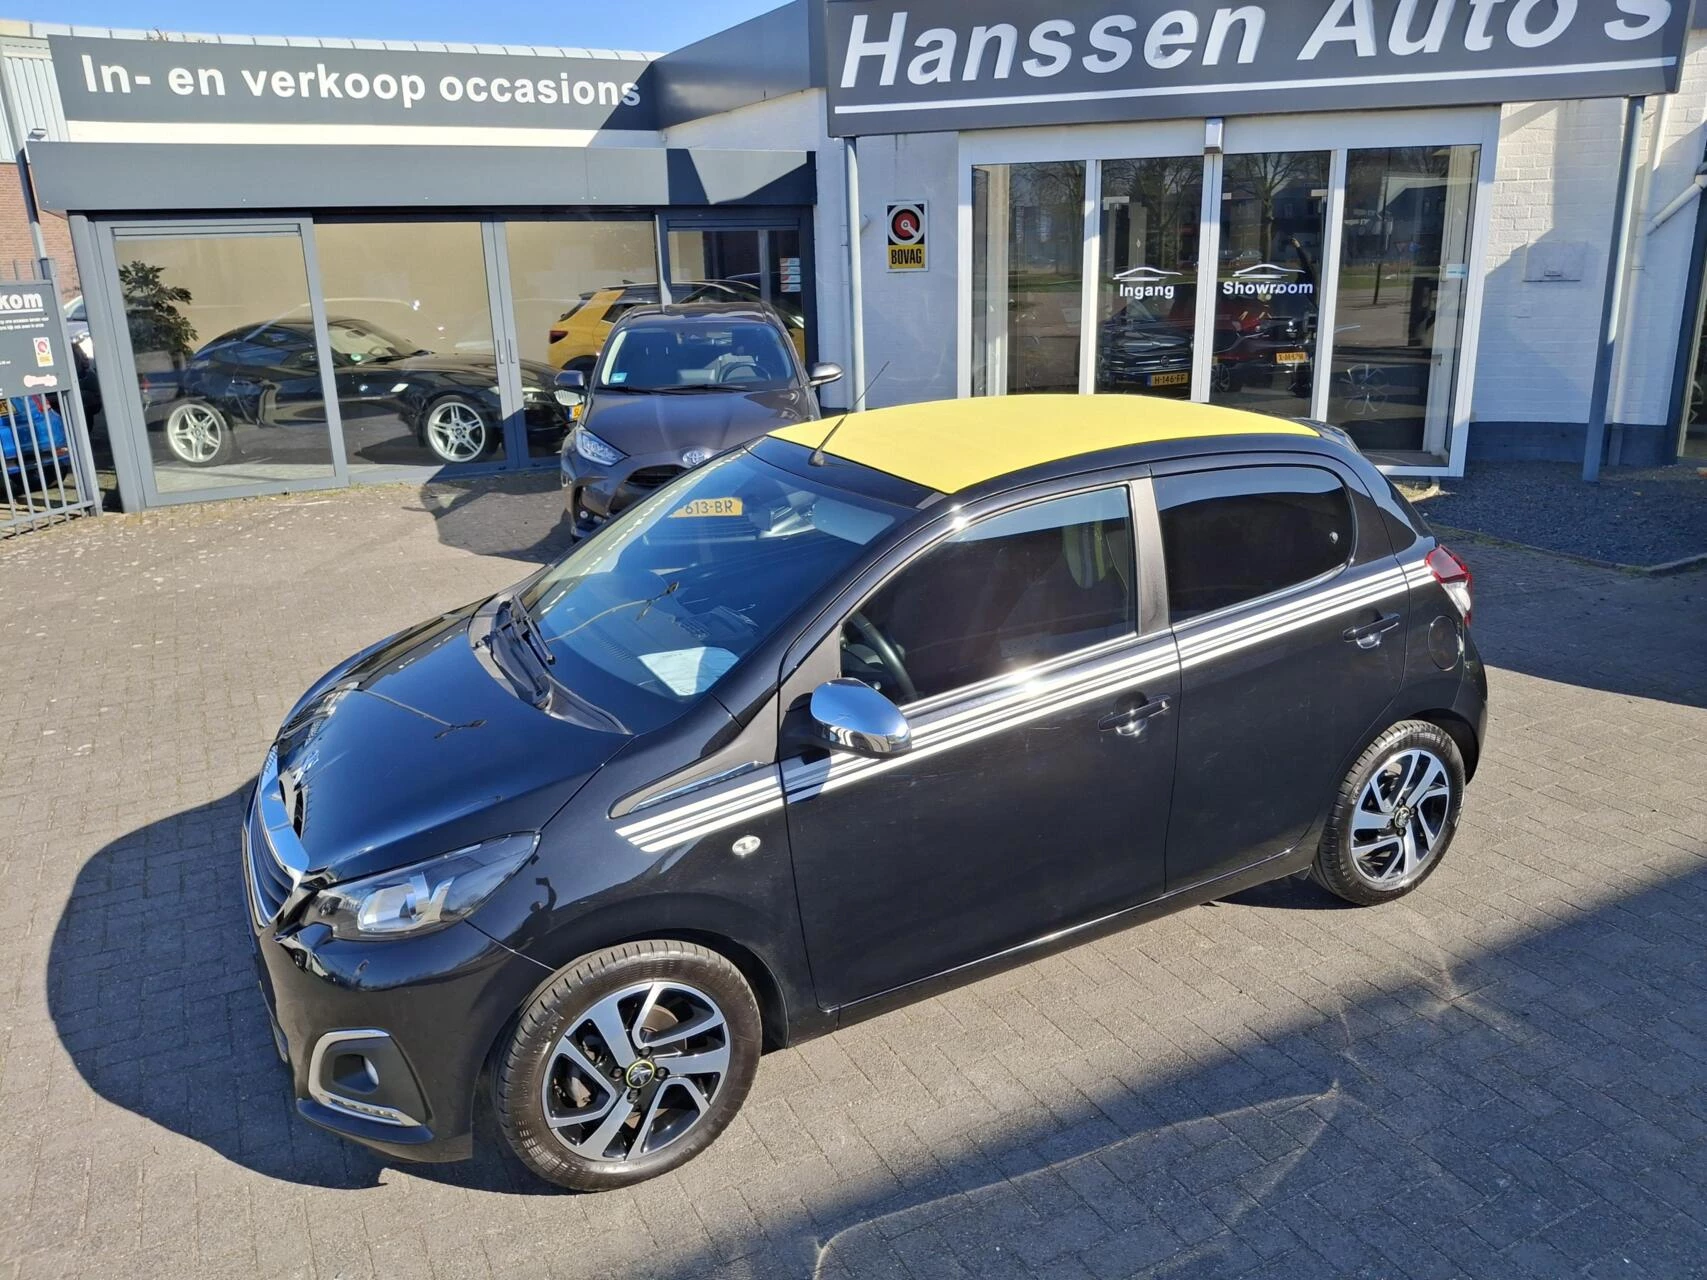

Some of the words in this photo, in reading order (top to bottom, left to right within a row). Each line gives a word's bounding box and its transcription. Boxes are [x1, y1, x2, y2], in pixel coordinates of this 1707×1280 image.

[839, 4, 1267, 88] Hanssen
[1296, 0, 1672, 61] Autos
[81, 54, 151, 94] In-
[168, 67, 226, 96] en
[241, 63, 426, 108] verkoop
[439, 72, 641, 106] occasions
[890, 249, 922, 265] BOVAG
[1119, 283, 1175, 300] Ingang
[1222, 281, 1314, 295] Showroom
